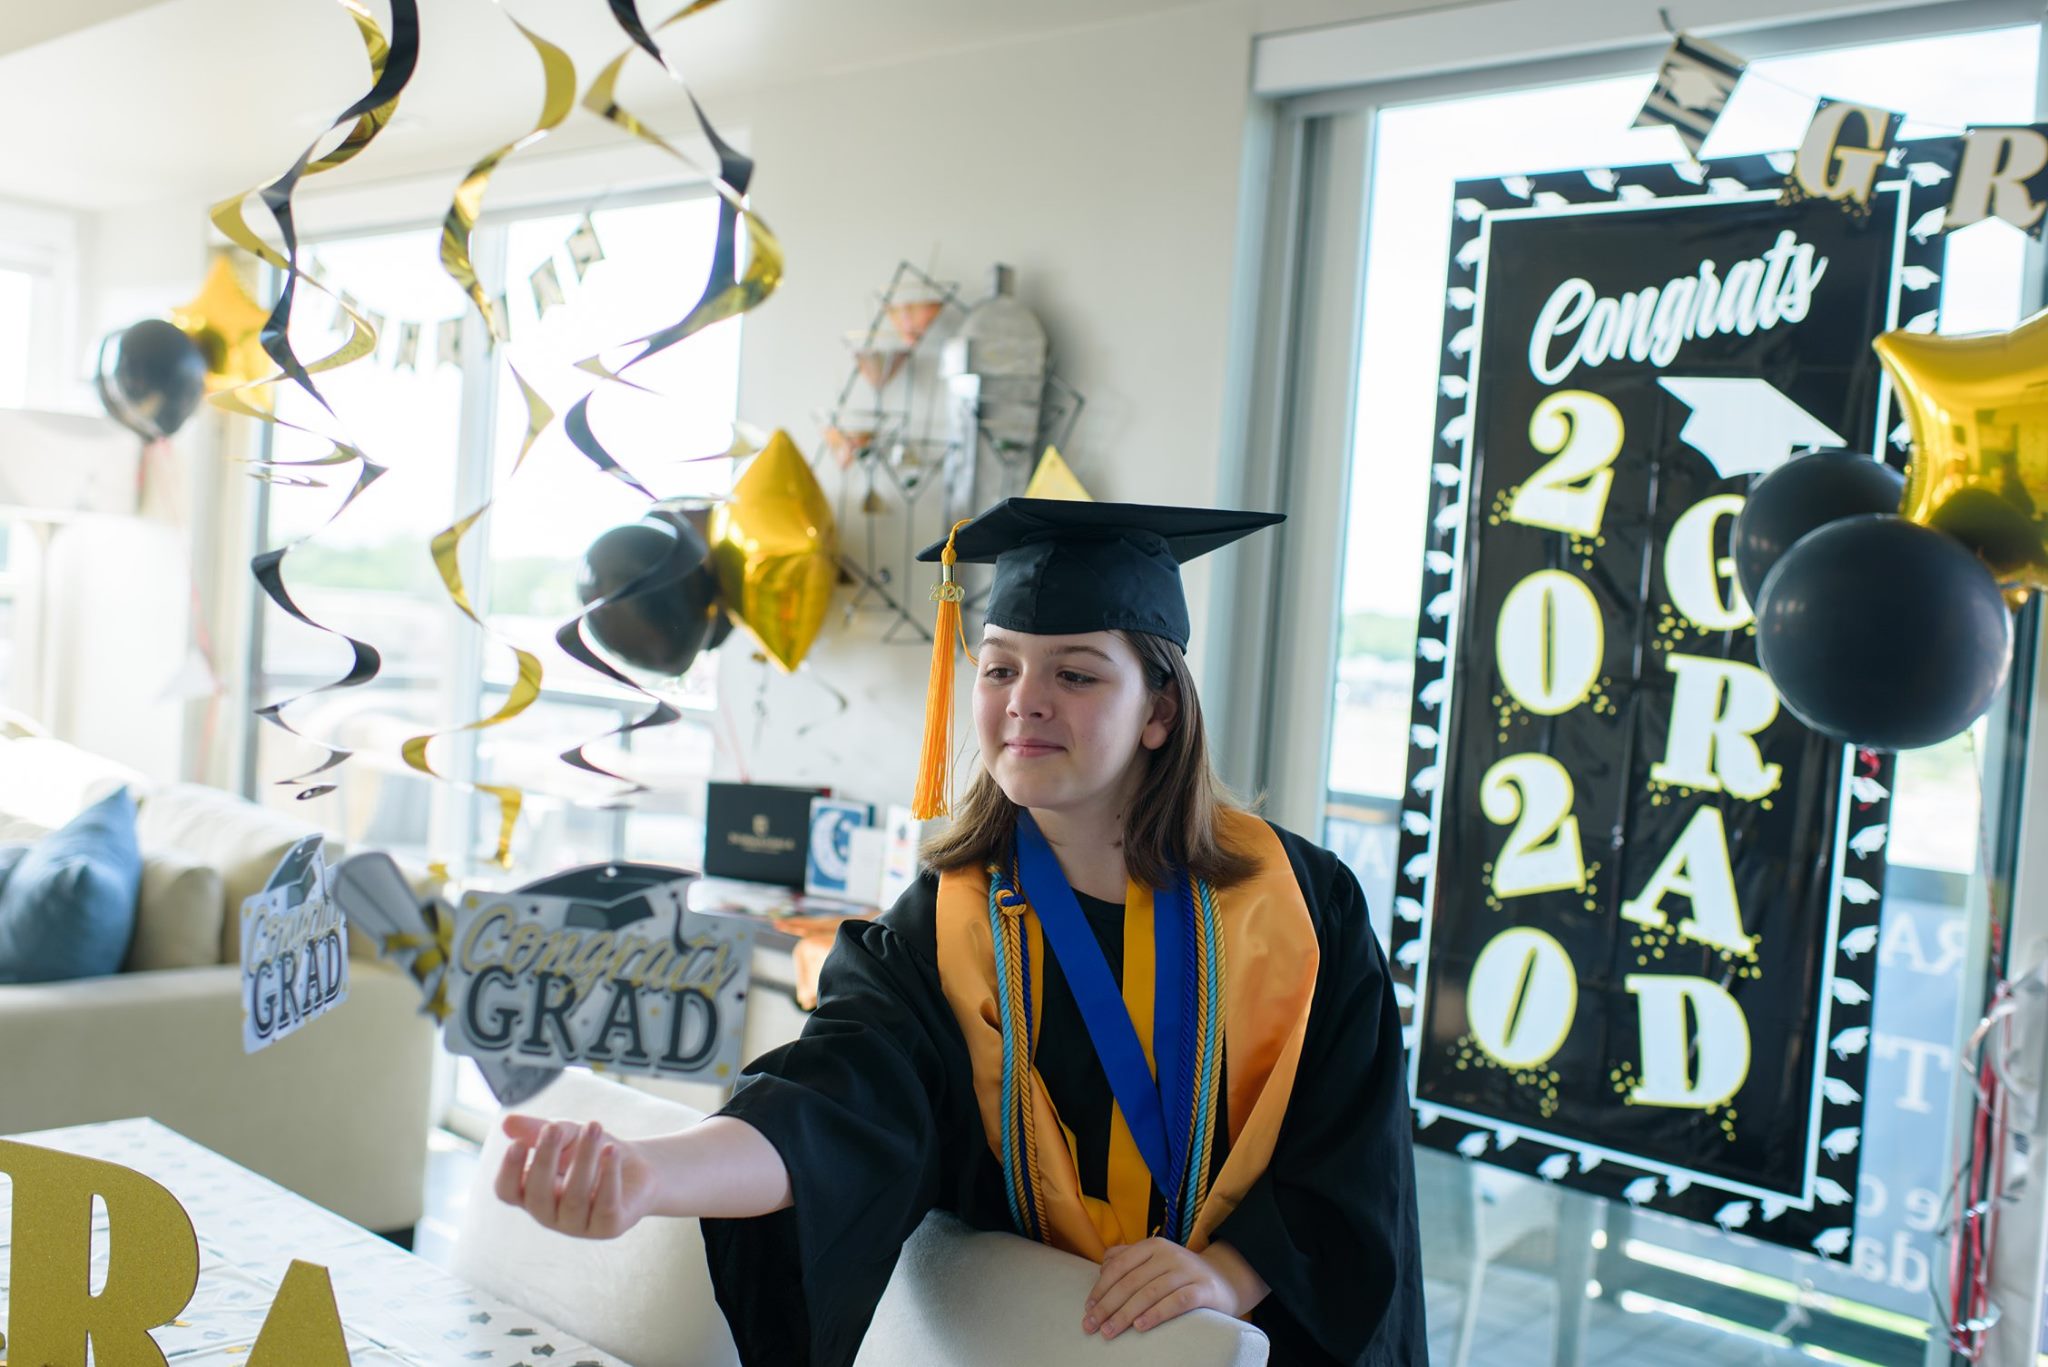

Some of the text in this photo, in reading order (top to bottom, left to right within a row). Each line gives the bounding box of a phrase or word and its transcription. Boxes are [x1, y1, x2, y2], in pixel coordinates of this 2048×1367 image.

[1528, 229, 1828, 385] Congrats
[929, 583, 965, 602] 2020
[253, 930, 342, 1038] GRAD
[462, 904, 736, 1003] Congrats
[466, 965, 720, 1072] GRAD
